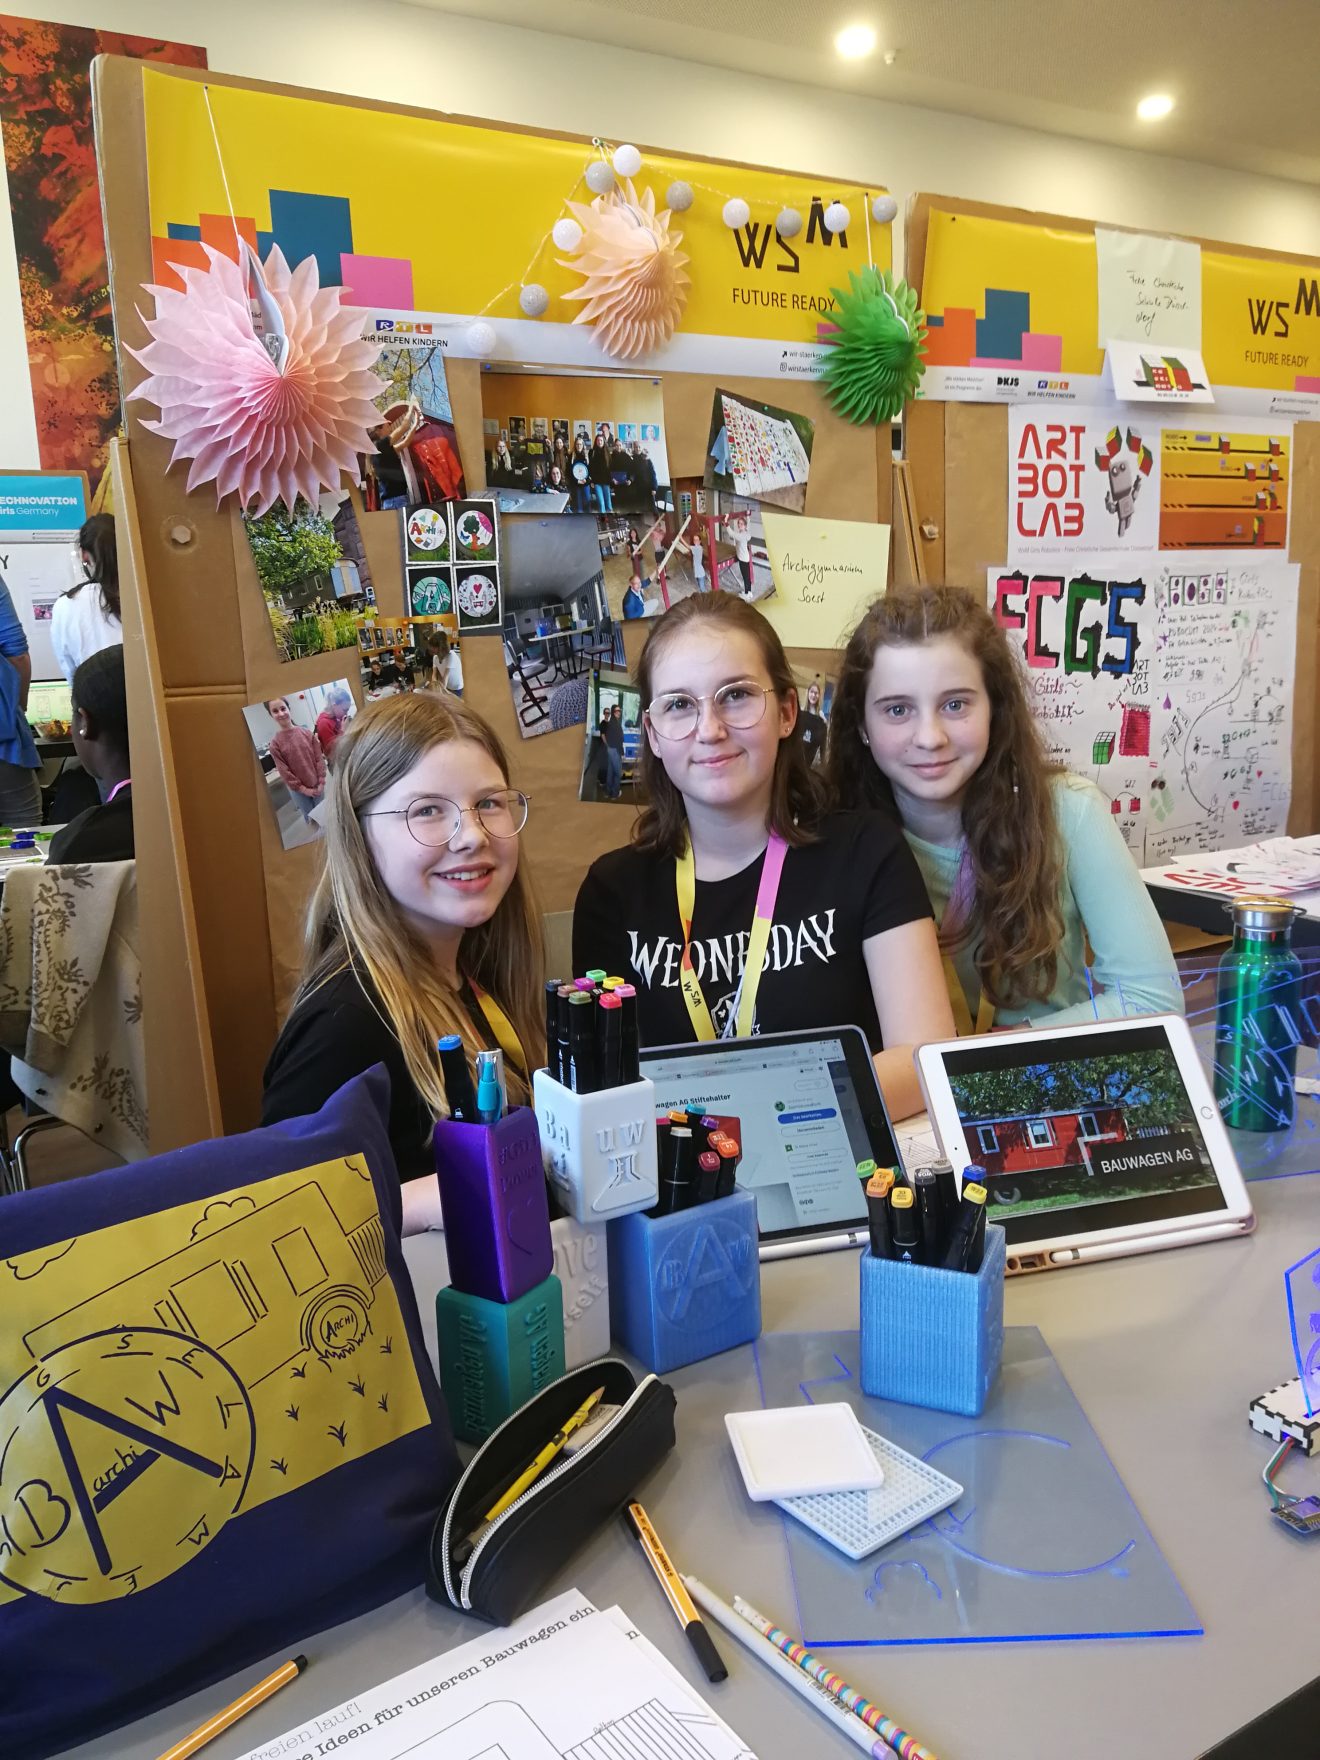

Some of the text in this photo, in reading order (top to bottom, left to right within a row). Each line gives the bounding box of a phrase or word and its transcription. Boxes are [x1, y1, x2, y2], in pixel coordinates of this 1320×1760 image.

[733, 288, 836, 312] FUTURE READY
[378, 336, 410, 345] HELFEN
[412, 338, 448, 348] KINDERN
[1244, 350, 1310, 368] FUTURE READY
[997, 376, 1019, 387] DKJS
[1018, 423, 1086, 460] ART
[1018, 463, 1086, 499] BOT
[0, 496, 78, 505] ECHNOVATION
[0, 506, 59, 517] irls Germany
[1017, 502, 1085, 537] LAB
[627, 908, 837, 990] WEDNEDAY
[655, 1100, 678, 1110] wagen
[1101, 1148, 1194, 1174] BAUWAGEN AG
[325, 1312, 356, 1342] ARCHI
[92, 1445, 144, 1494] archi
[314, 1605, 597, 1757] Ideen für unseren Bauwagen ein
[314, 1701, 362, 1734] lauf!
